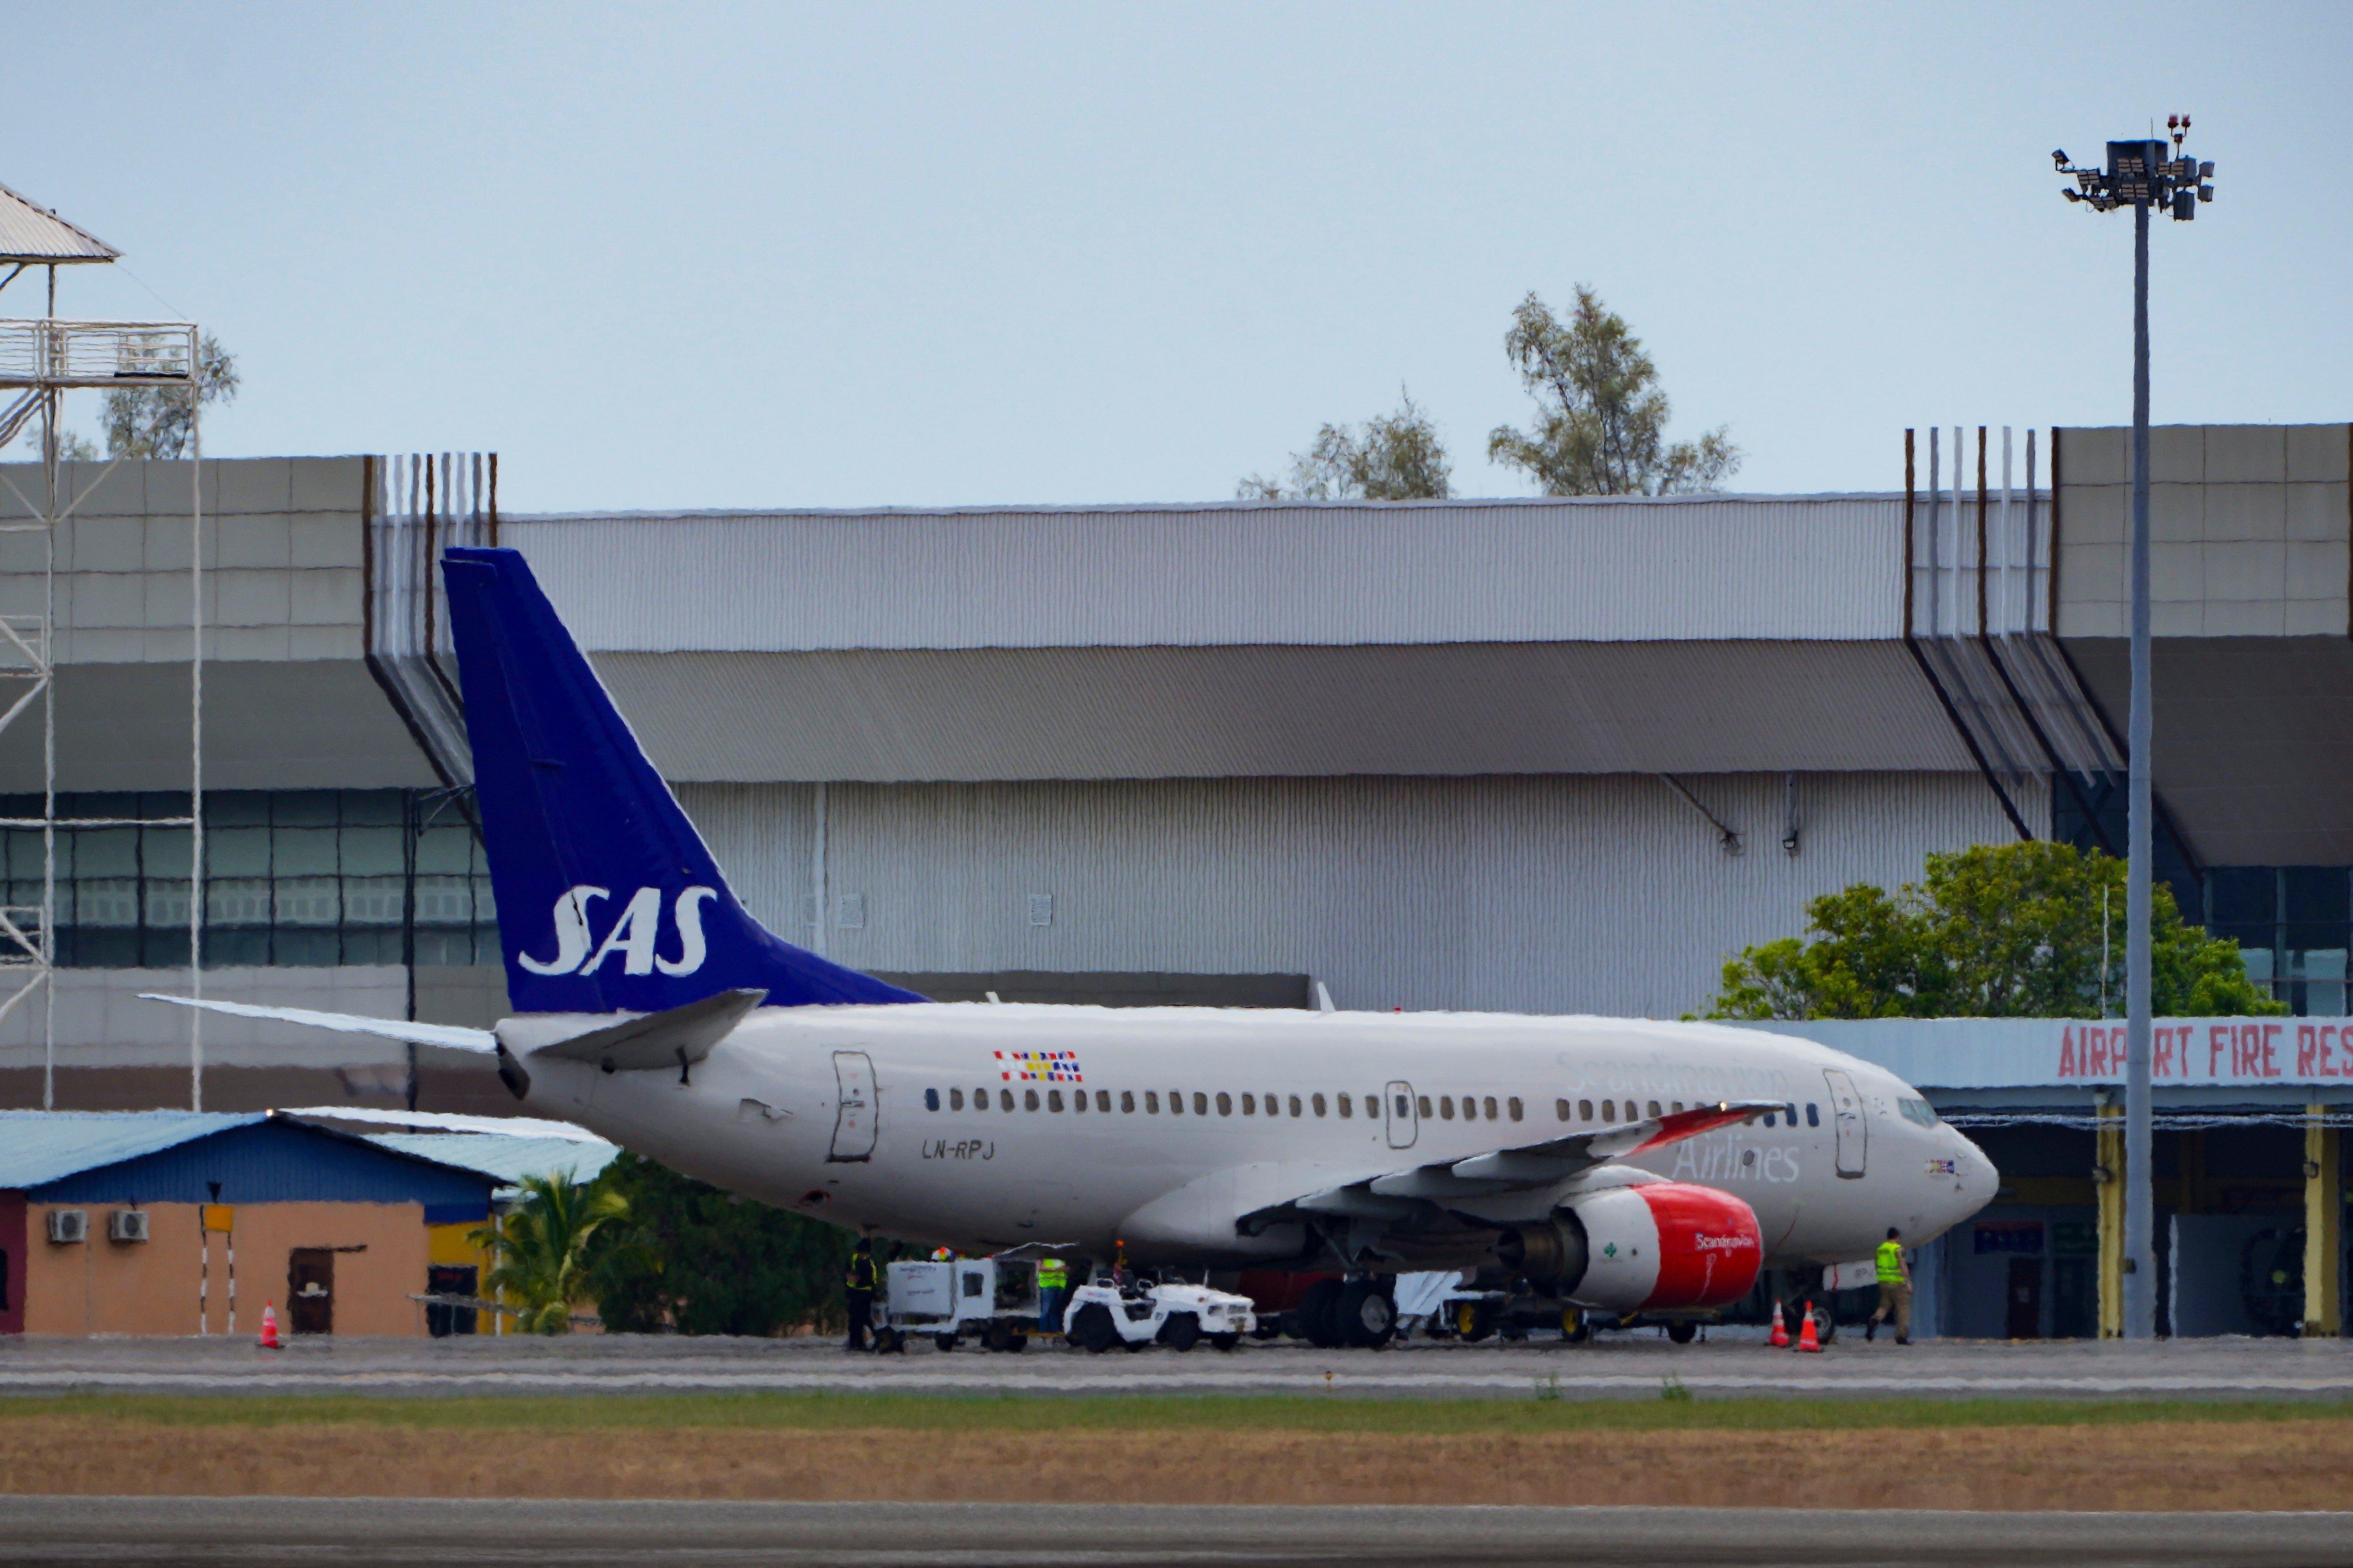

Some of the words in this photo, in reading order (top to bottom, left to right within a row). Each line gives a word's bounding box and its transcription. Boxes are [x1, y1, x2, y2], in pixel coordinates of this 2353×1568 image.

[518, 885, 718, 977] SAS
[1556, 1051, 1793, 1097] Scandinavian
[2058, 1025, 2193, 1078] AIRPRT
[2209, 1024, 2282, 1078] FIRE
[922, 1139, 995, 1160] LN-RPJ
[1671, 1133, 1800, 1183] Airlines
